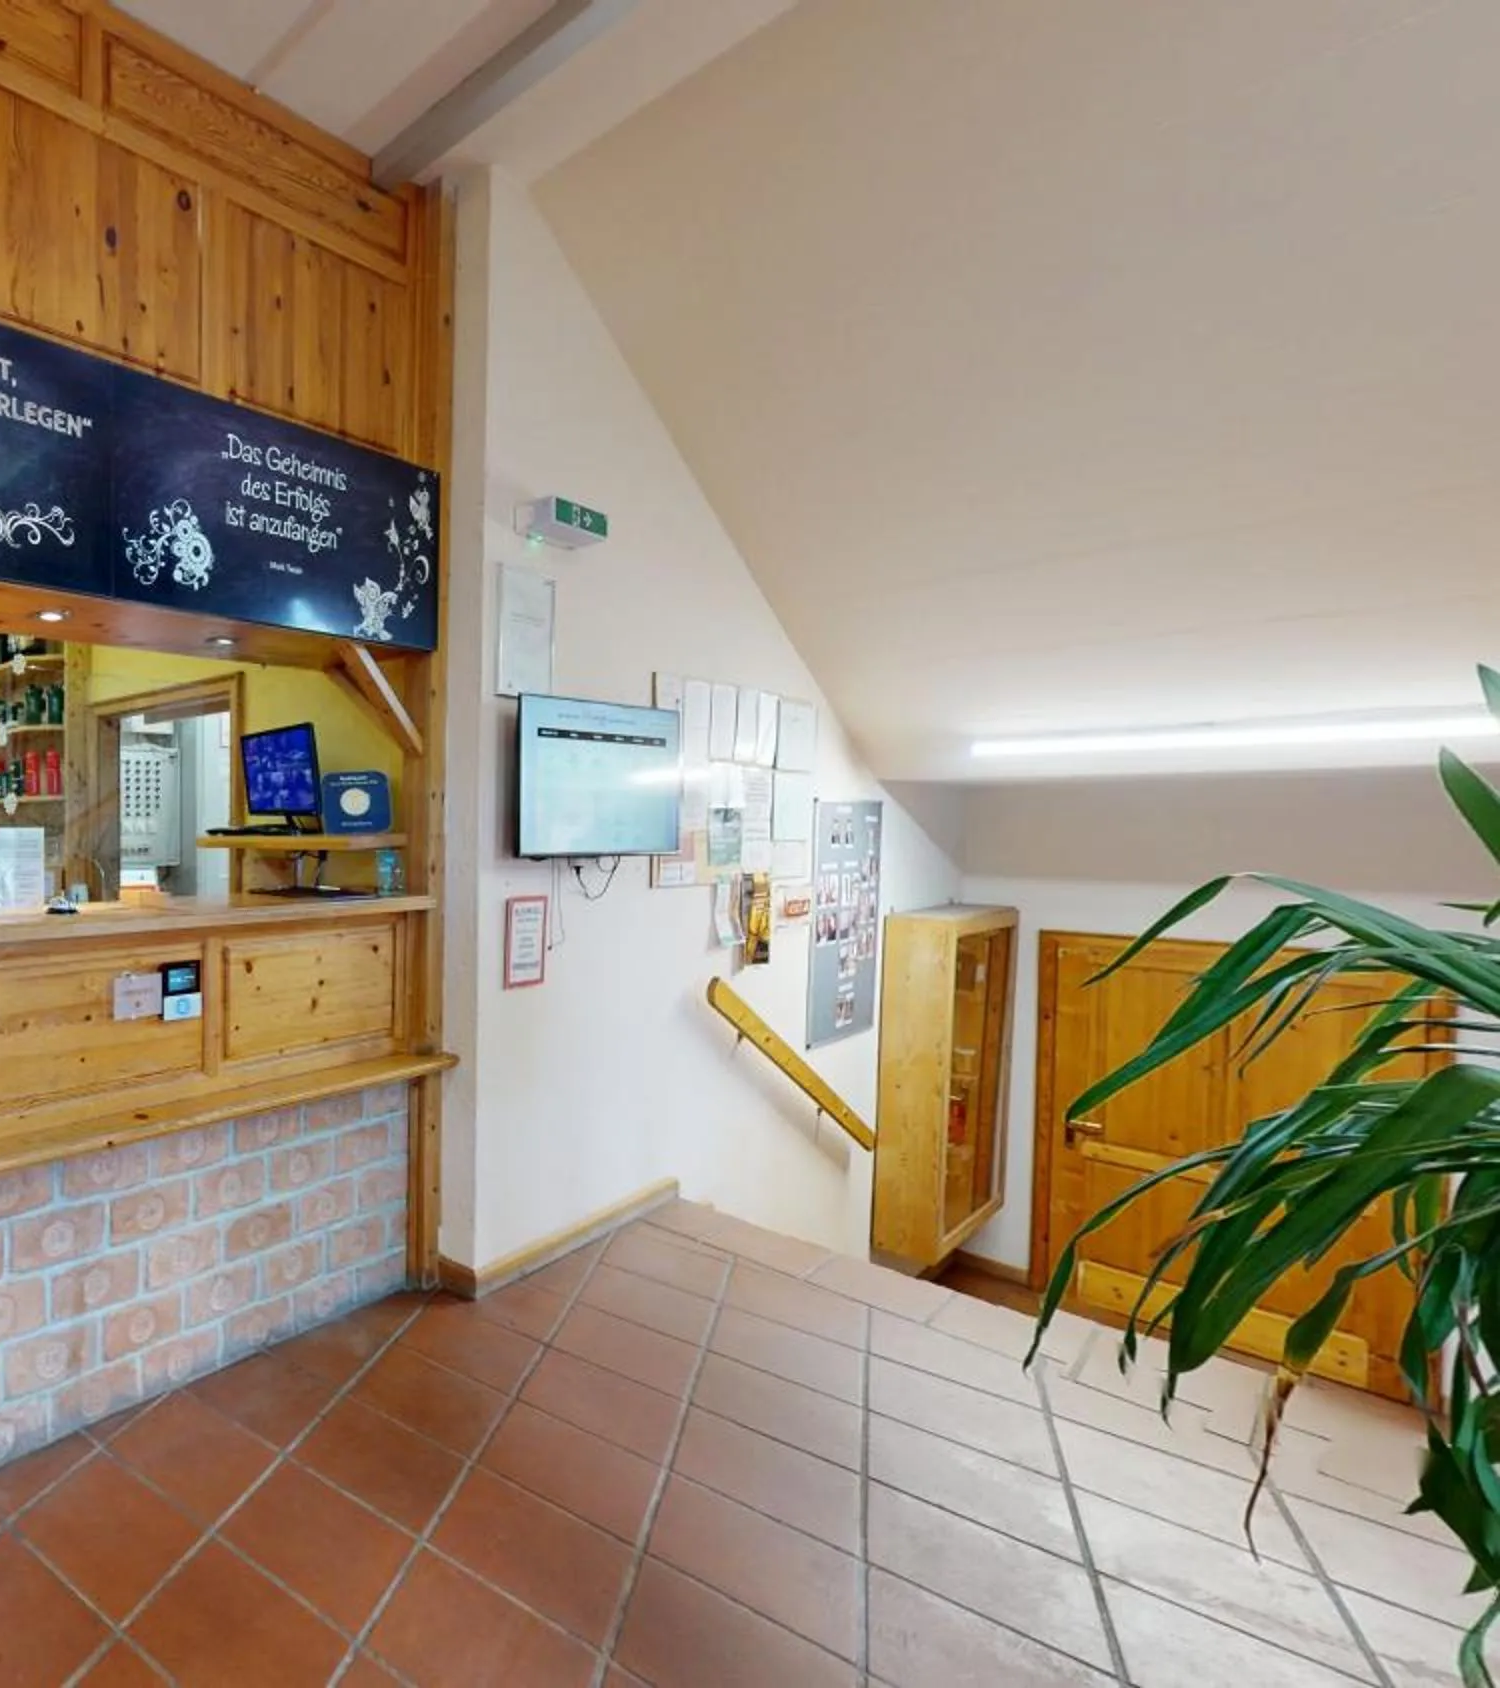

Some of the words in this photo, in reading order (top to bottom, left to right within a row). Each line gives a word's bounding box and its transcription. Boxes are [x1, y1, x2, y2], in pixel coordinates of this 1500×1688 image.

[265, 446, 348, 492] Geheimnis
[225, 500, 247, 528] ist
[241, 472, 271, 501] des
[275, 481, 332, 523] Erfolgs
